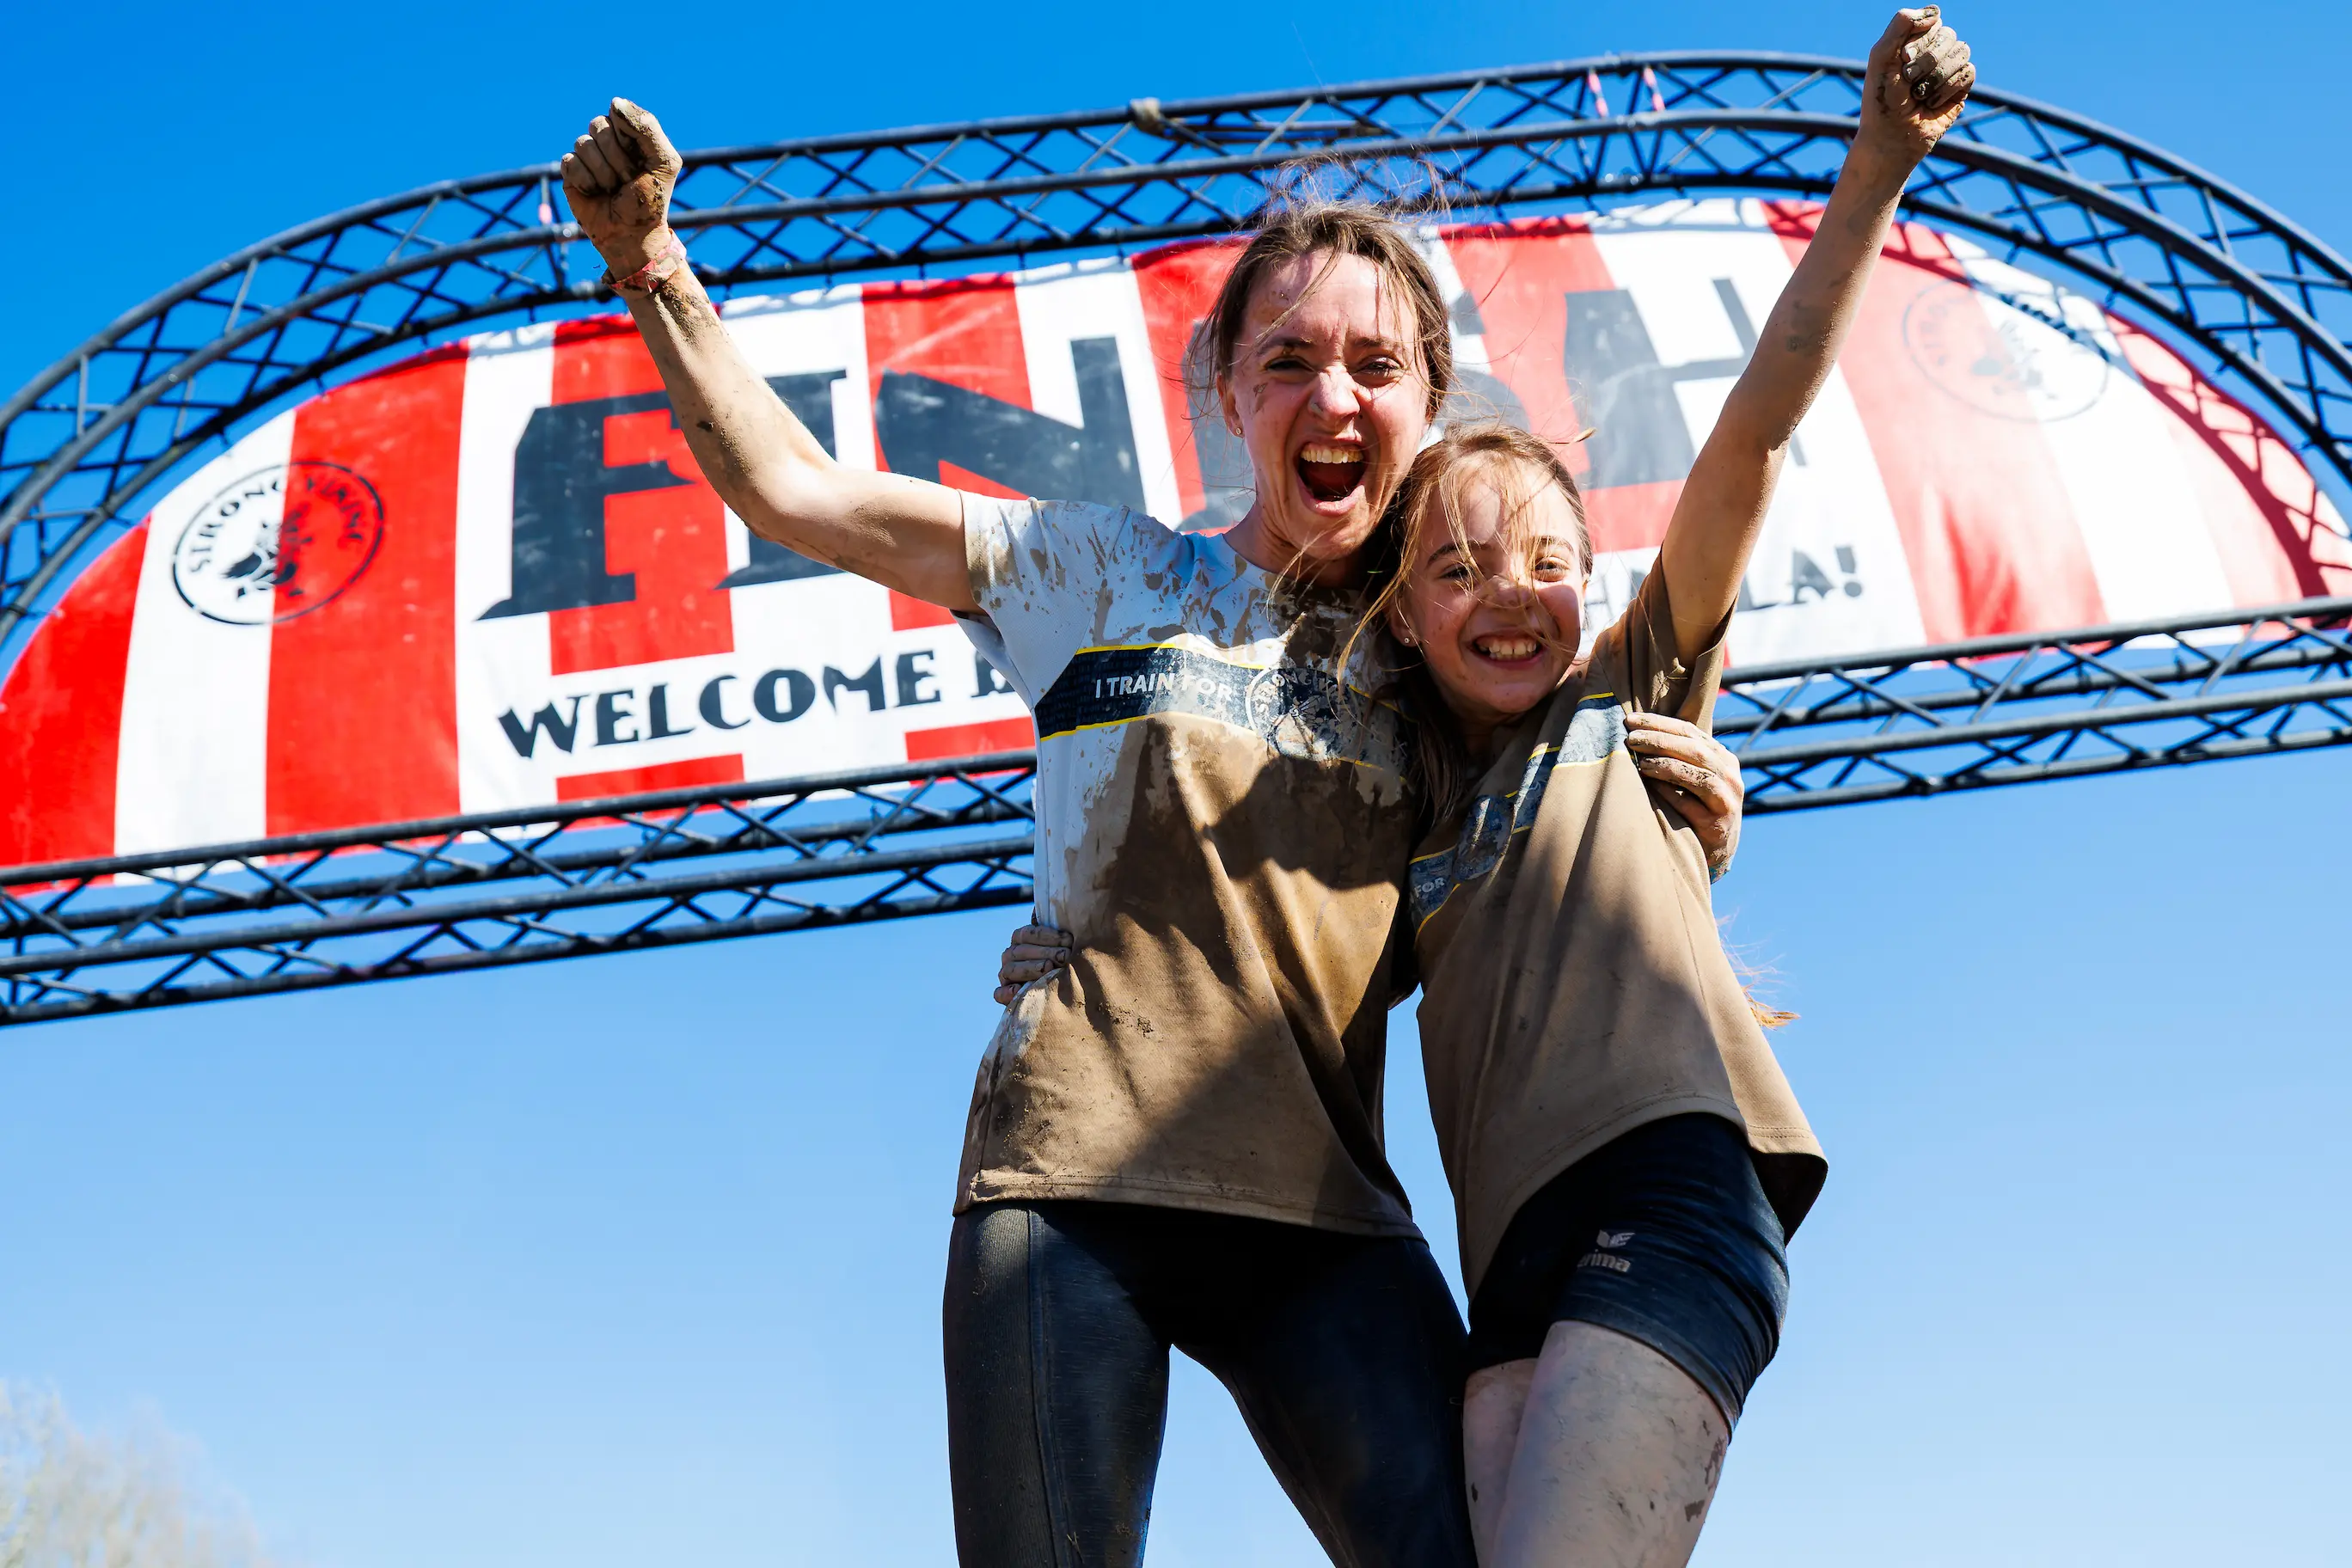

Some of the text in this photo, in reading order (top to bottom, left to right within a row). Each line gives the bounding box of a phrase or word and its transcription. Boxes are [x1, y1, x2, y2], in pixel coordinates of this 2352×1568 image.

[1106, 672, 1175, 697] TRAIN
[1181, 672, 1233, 701] FOR
[497, 649, 942, 759] WELCOME
[1414, 876, 1445, 898] FOR
